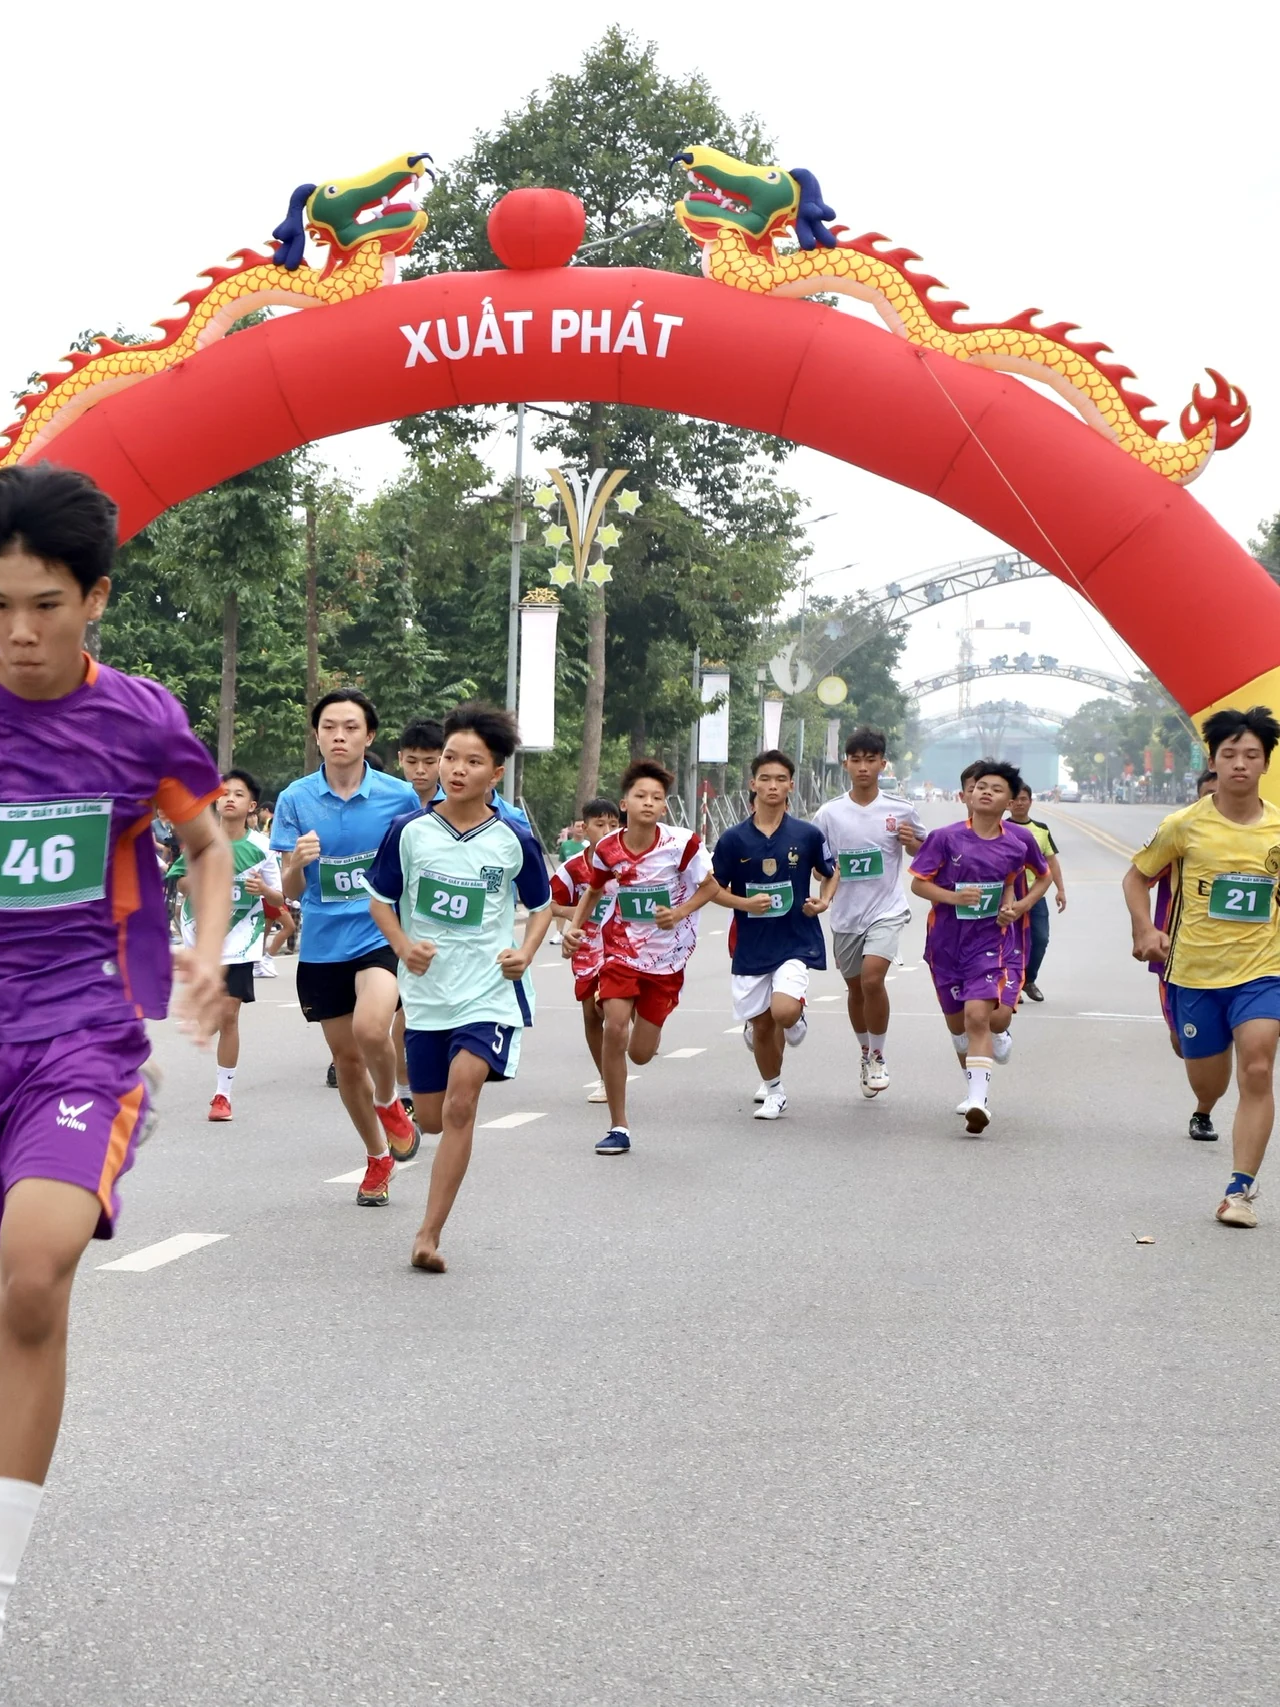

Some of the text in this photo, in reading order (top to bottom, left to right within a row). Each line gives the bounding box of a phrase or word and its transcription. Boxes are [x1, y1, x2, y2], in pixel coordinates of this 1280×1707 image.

[399, 296, 683, 368] XUẤT PHÁT
[1, 834, 75, 884] 46
[850, 858, 871, 873] 27
[334, 868, 365, 892] 66
[431, 890, 468, 918] 29
[632, 898, 657, 914] 14
[1225, 888, 1256, 911] 21
